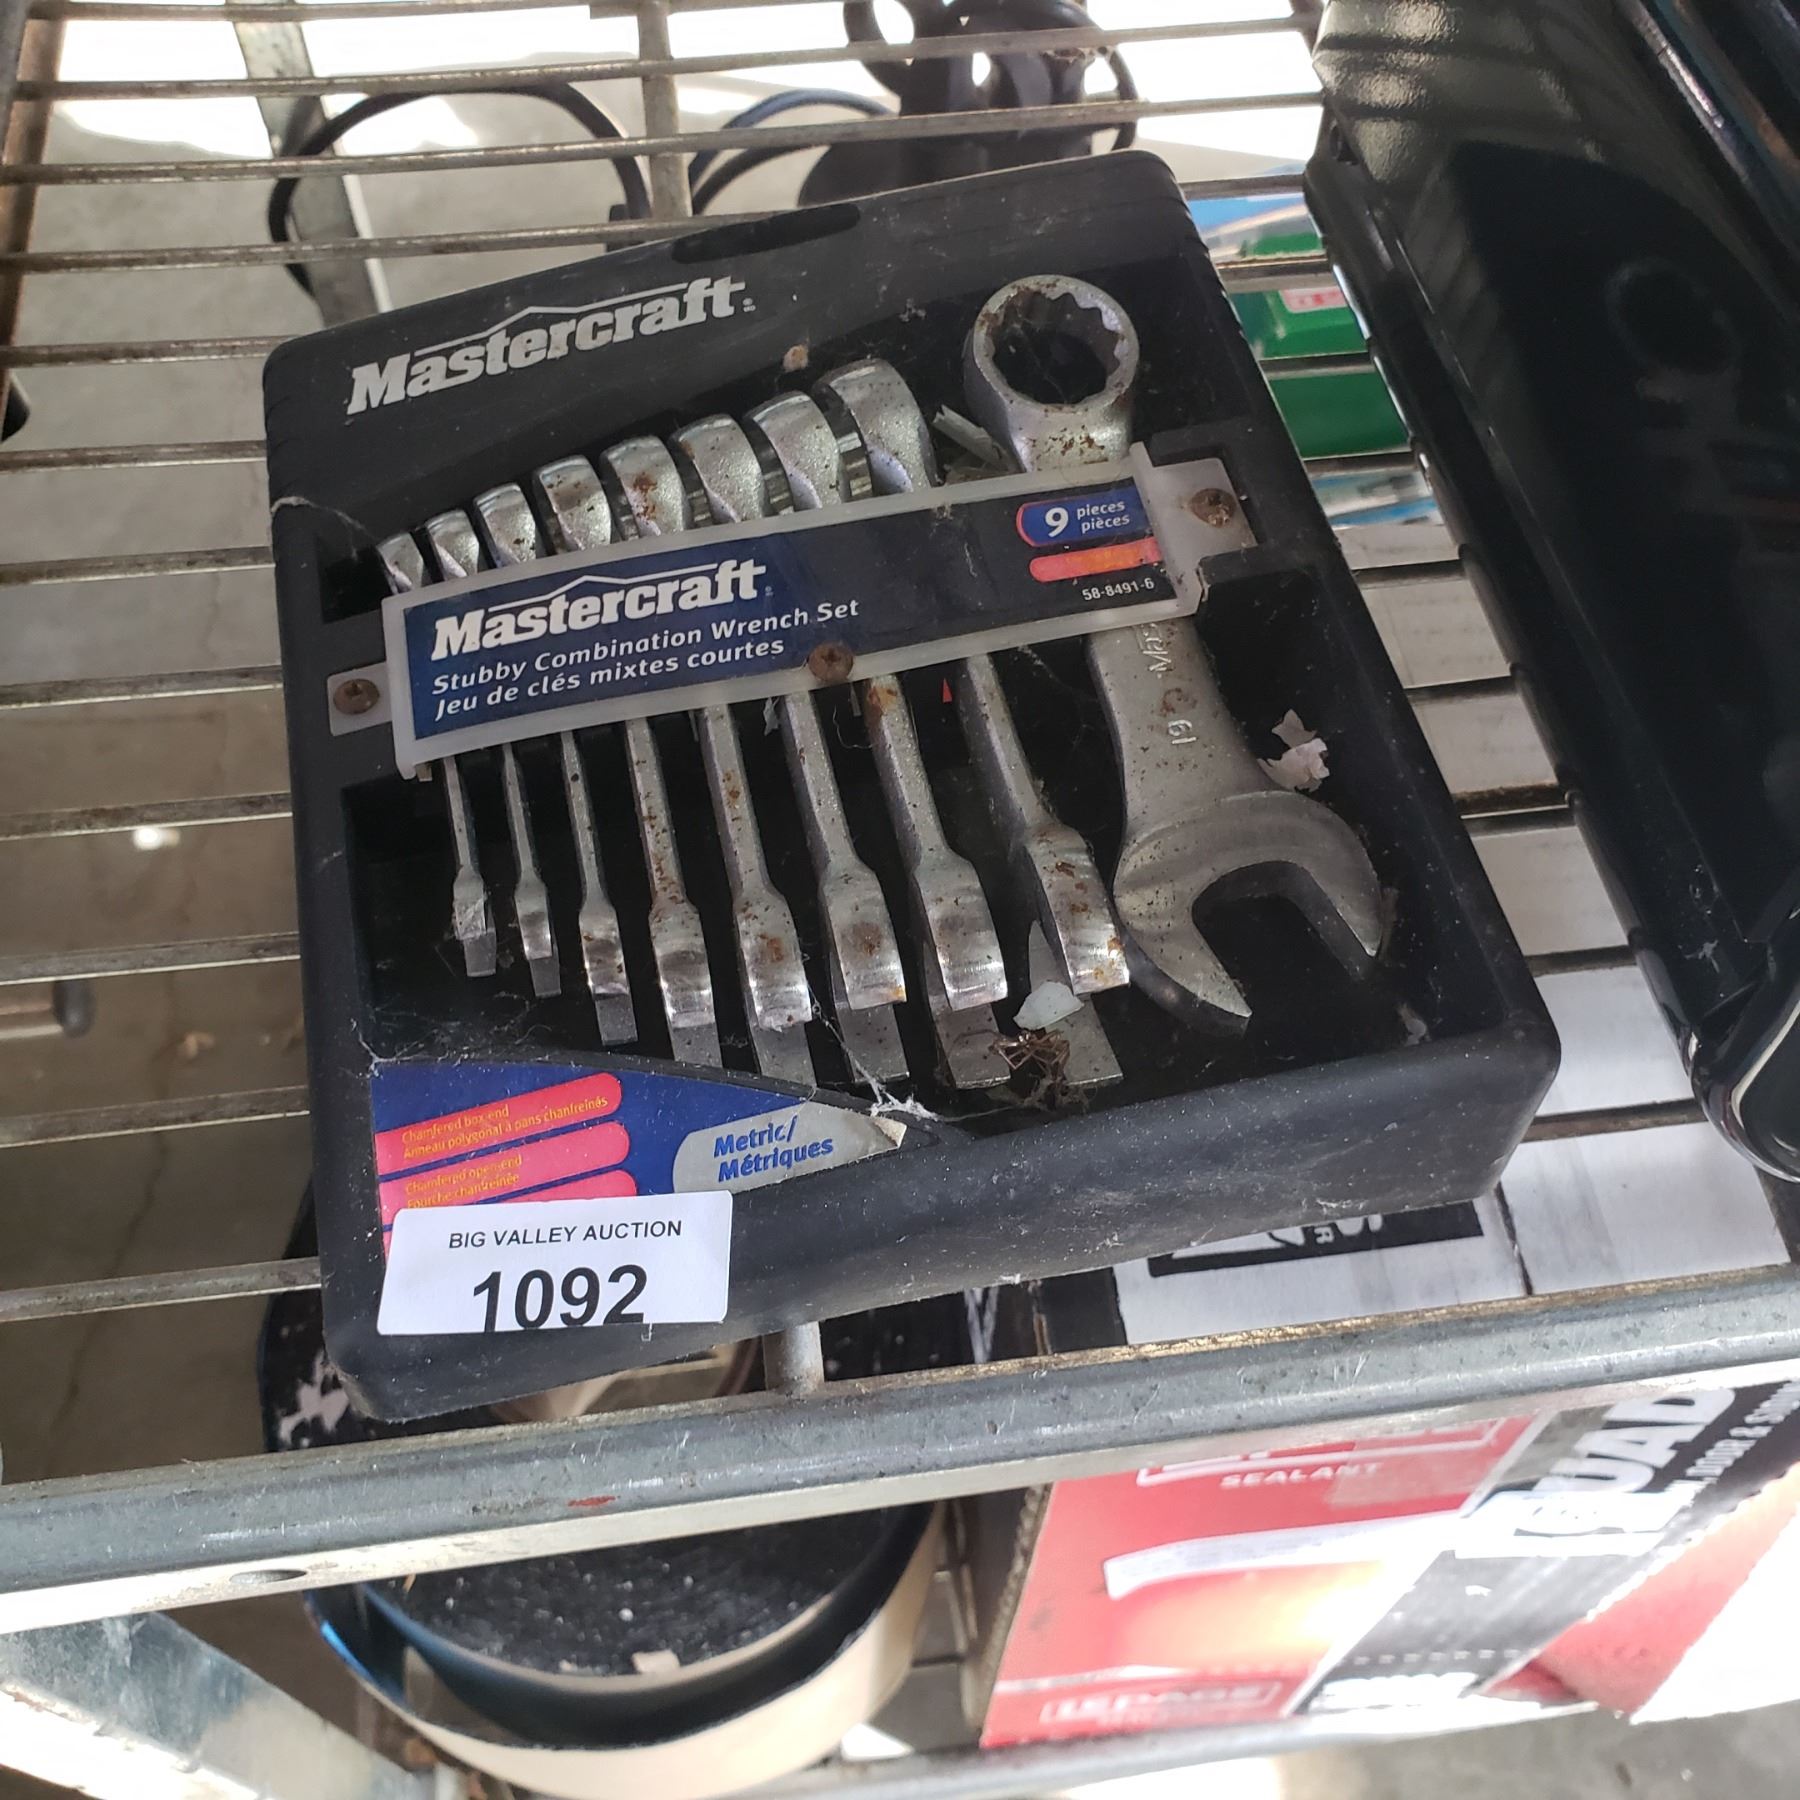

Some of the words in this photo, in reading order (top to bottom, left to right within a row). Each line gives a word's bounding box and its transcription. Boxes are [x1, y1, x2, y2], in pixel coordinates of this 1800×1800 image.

[347, 276, 746, 415] Mastercraft
[1045, 507, 1069, 537] 9
[1077, 501, 1125, 520] pieces
[1081, 514, 1130, 534] pièces
[1082, 577, 1155, 601] 58-8491-6
[431, 559, 767, 661] Mastercraft
[432, 661, 527, 695] Stubby
[534, 627, 701, 671] Combination
[711, 608, 808, 640] Wrench
[817, 599, 859, 622] Set
[435, 695, 478, 722] Jeu
[486, 686, 519, 705] de
[527, 673, 581, 697] clés
[590, 655, 679, 685] mixtes
[687, 639, 785, 669] courtes
[1168, 719, 1198, 745] 19
[402, 1116, 462, 1143] Chamfered
[448, 1124, 502, 1150] polygonal
[515, 1114, 542, 1130] pans
[713, 1114, 798, 1159] Metric/
[718, 1138, 834, 1182] Métriques
[449, 1231, 486, 1249] BIG
[494, 1226, 577, 1246] VALLEY
[583, 1220, 683, 1242] AUCTION
[473, 1264, 648, 1333] 1092
[1219, 1461, 1384, 1489] SEALANT
